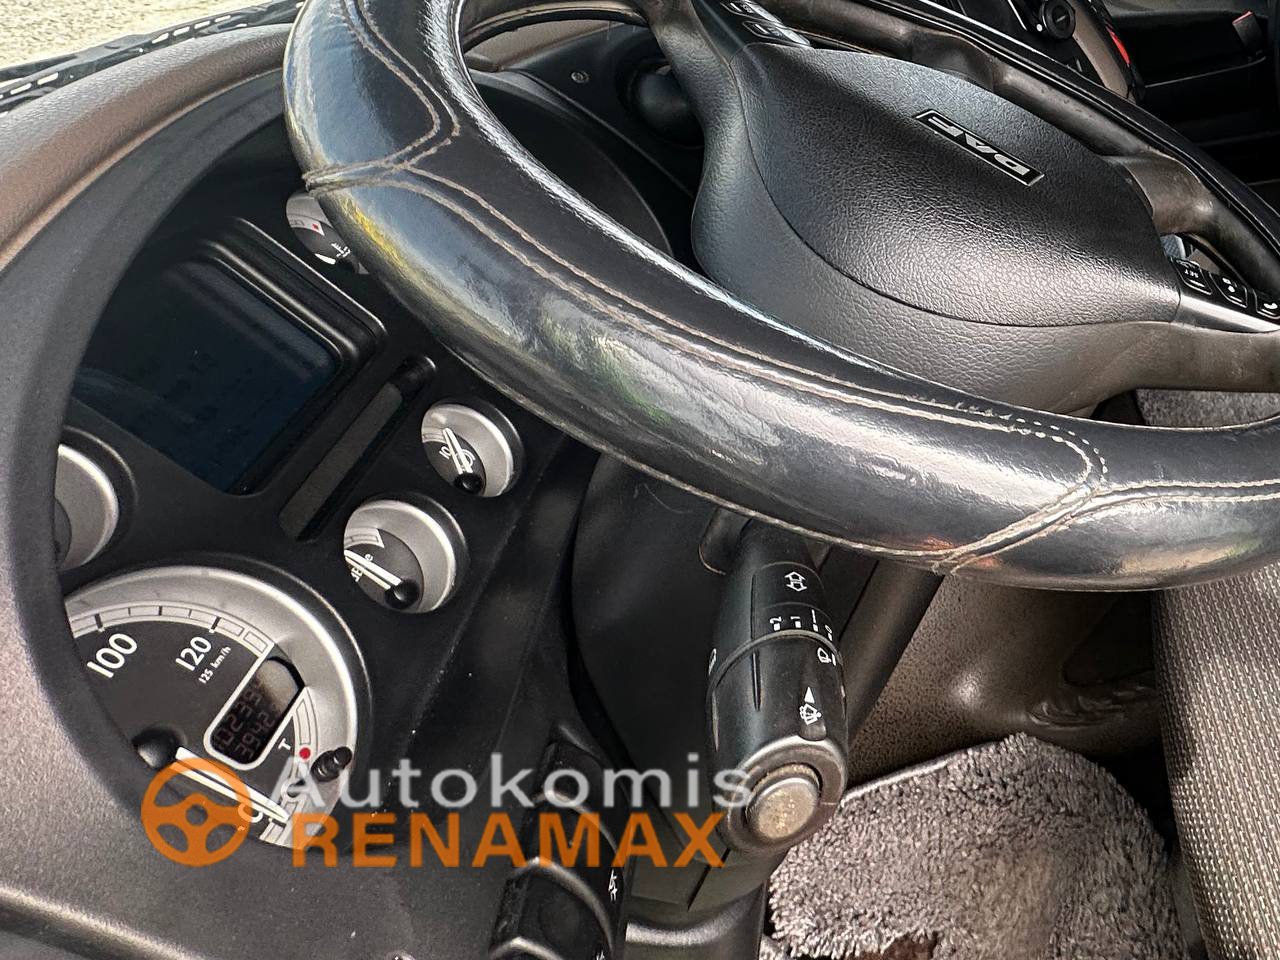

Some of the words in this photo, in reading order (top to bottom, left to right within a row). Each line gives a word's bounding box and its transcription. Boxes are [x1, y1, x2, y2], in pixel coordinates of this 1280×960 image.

[928, 116, 1030, 176] DAF
[86, 633, 138, 678] 100
[175, 636, 212, 671] 120
[198, 668, 214, 684] 125
